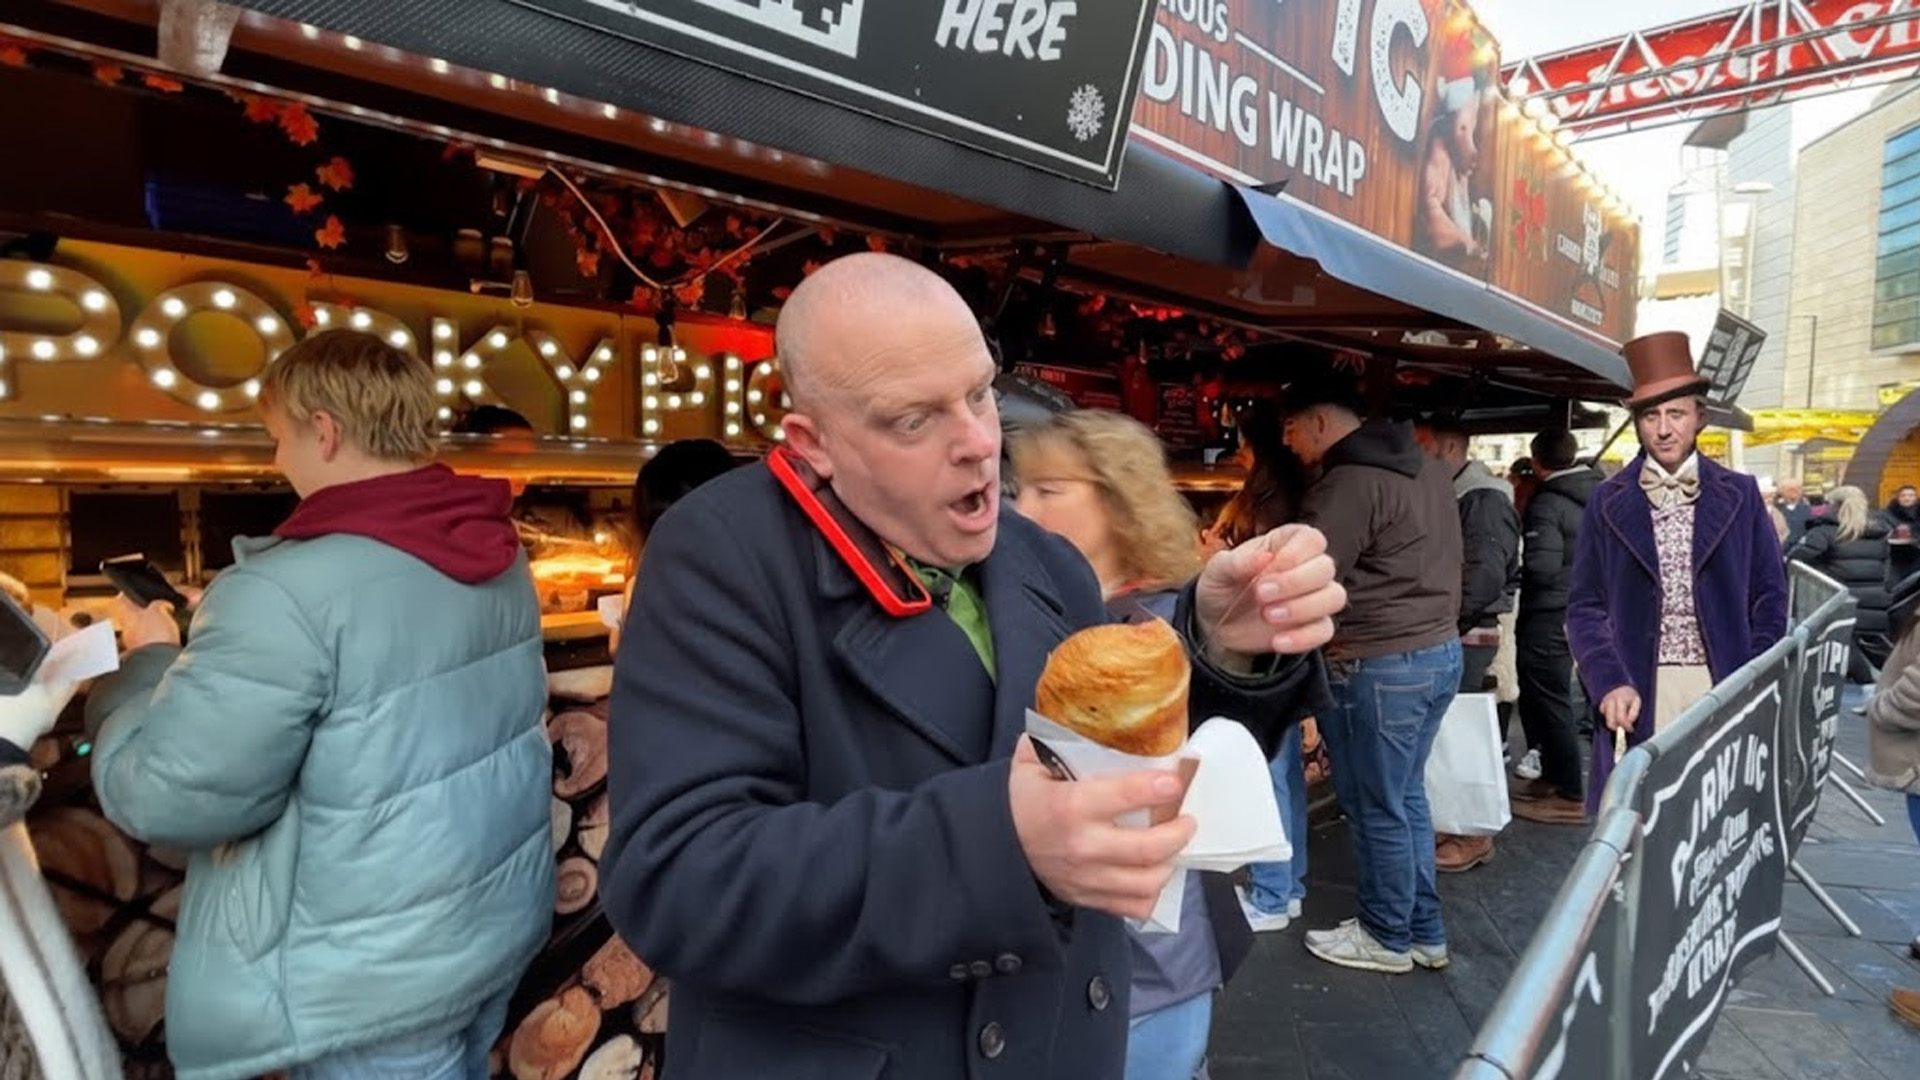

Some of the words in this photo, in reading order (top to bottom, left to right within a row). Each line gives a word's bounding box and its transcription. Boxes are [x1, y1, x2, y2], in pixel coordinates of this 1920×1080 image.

[934, 0, 1078, 62] HERE
[1141, 24, 1259, 147] DING
[1268, 90, 1366, 198] WRAP
